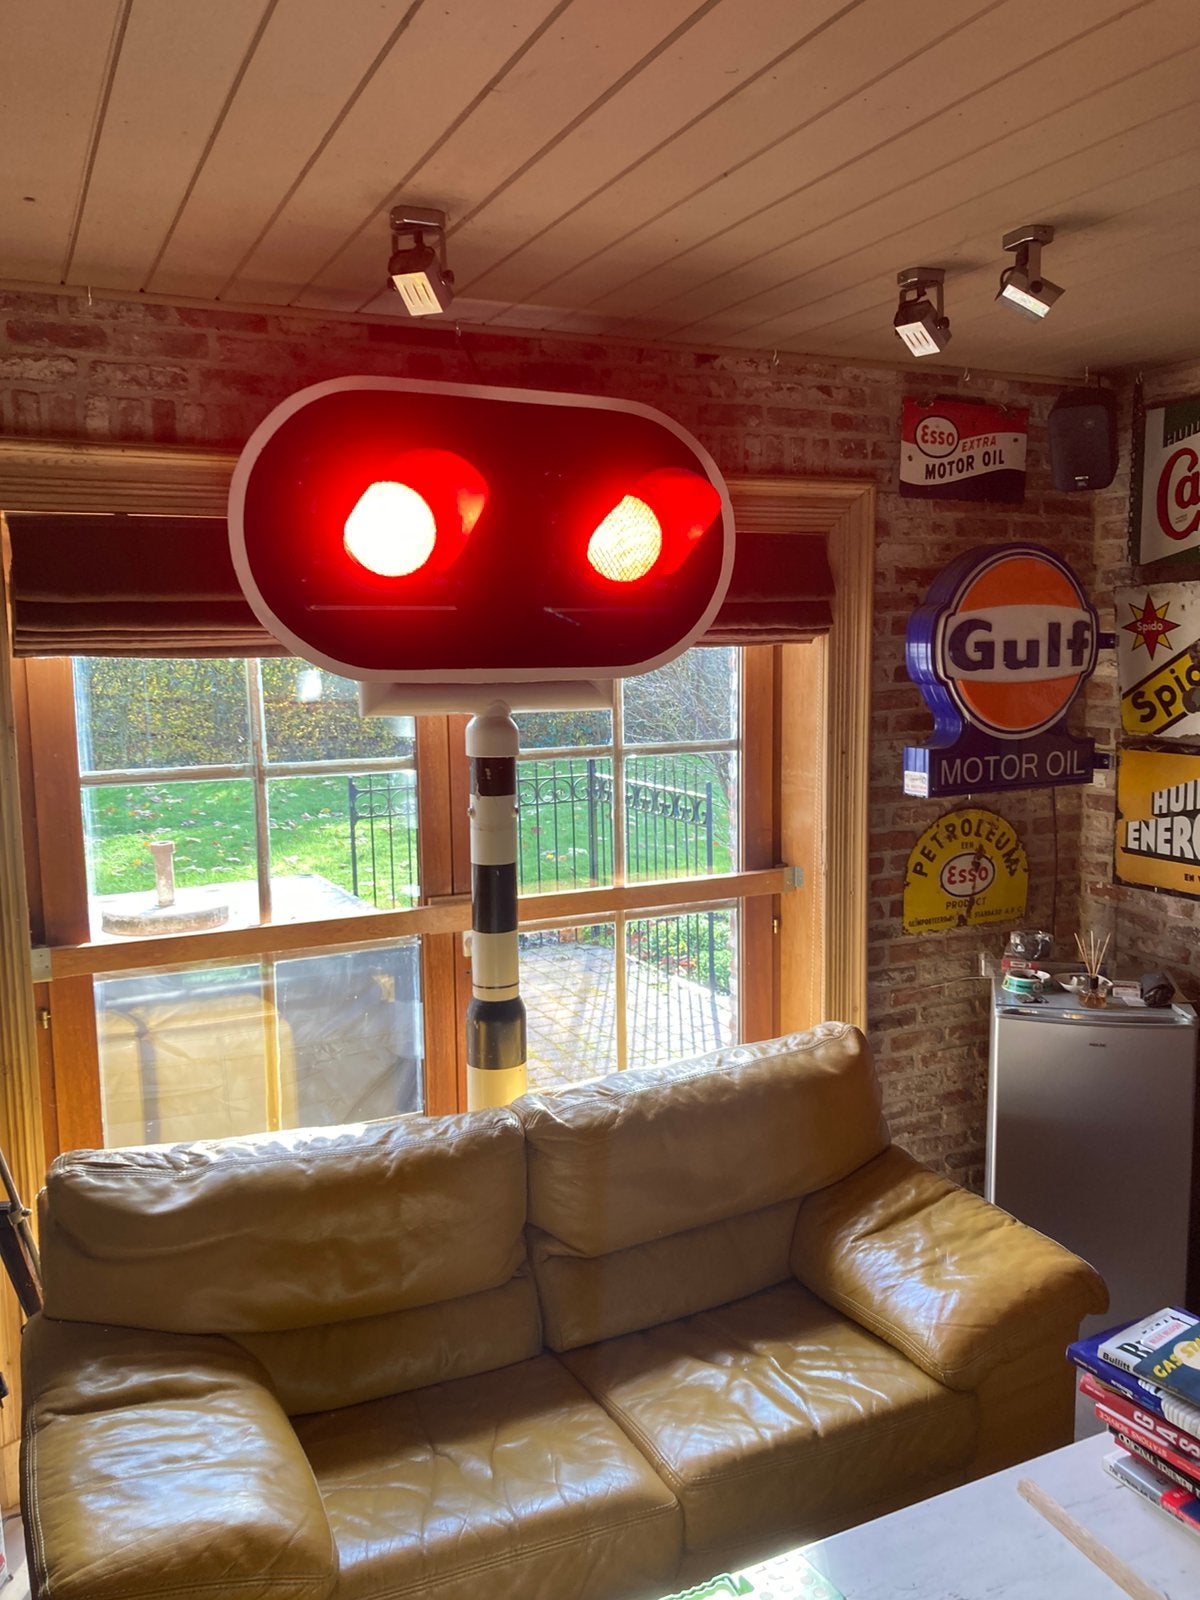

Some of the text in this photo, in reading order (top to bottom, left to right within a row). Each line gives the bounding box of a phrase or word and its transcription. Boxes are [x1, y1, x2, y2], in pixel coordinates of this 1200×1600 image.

[962, 436, 997, 453] EXTRA
[925, 449, 1004, 480] MOTOR OIL
[1136, 621, 1164, 633] Spido
[949, 619, 1091, 671] Gulf
[941, 754, 1038, 785] MOTOR
[1046, 751, 1085, 776] OIL
[912, 817, 1020, 877] PETROLEUM
[945, 897, 987, 910] PRODCT
[1102, 1351, 1132, 1372] Bullitt
[1153, 1353, 1183, 1378] GAS
[1133, 1410, 1200, 1458] GAS
